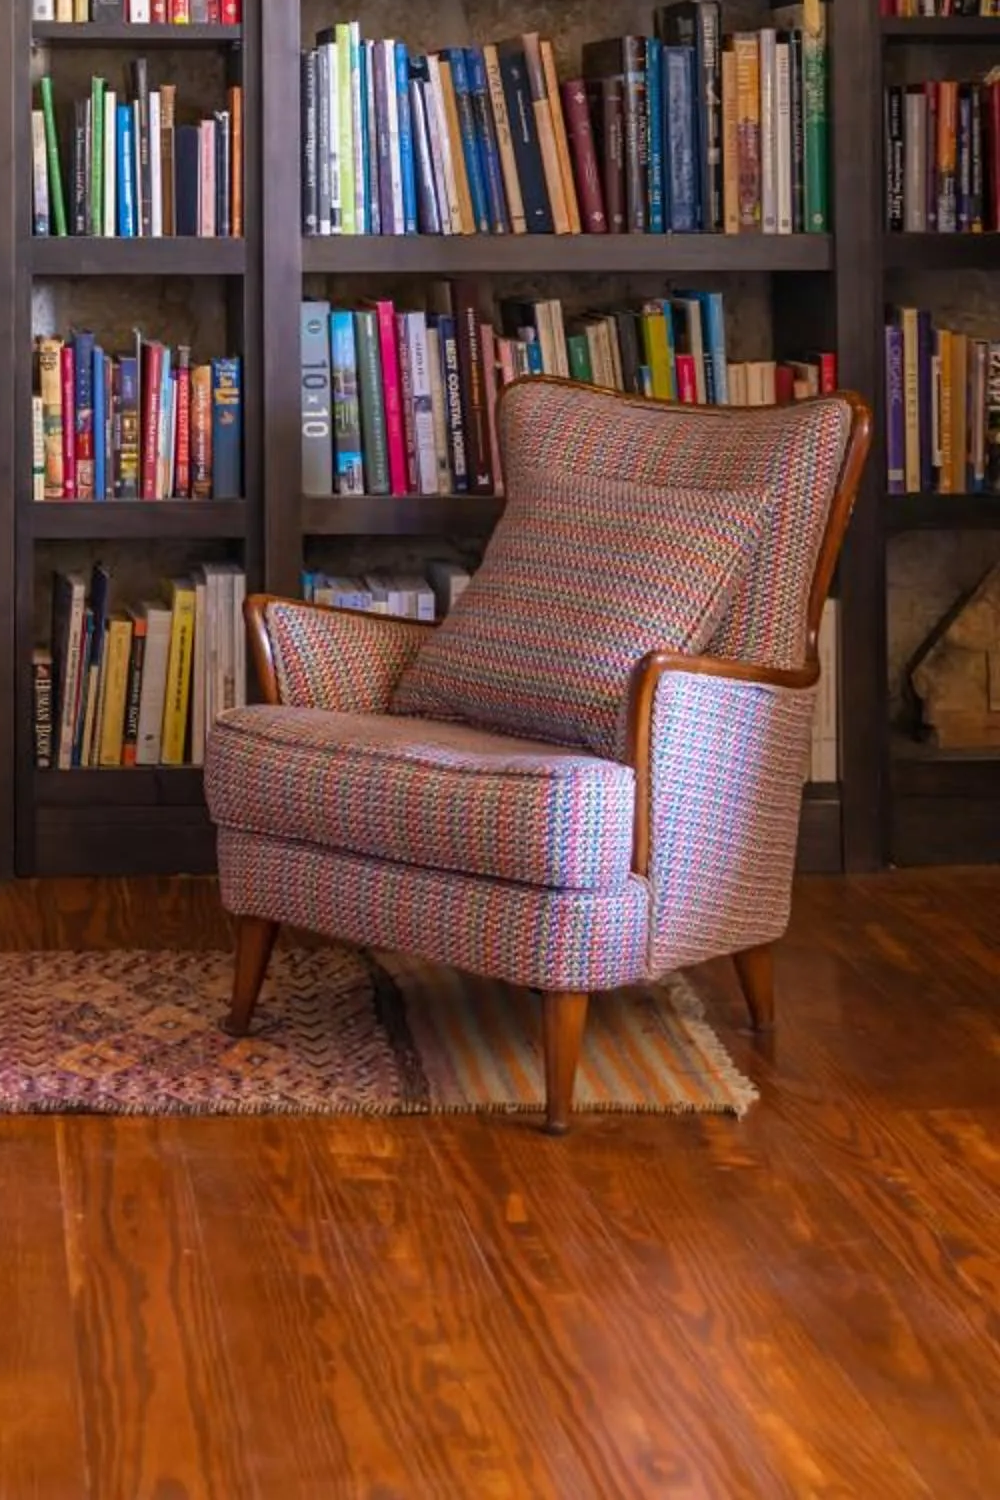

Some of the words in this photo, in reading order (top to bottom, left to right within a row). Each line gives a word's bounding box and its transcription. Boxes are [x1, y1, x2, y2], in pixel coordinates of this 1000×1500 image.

[445, 339, 458, 369] BEST
[303, 359, 328, 390] 10
[447, 373, 462, 427] COASTAL
[303, 406, 329, 437] 10
[453, 431, 465, 476] HOMES
[35, 679, 52, 721] HUMAN
[35, 724, 51, 757] BODY
